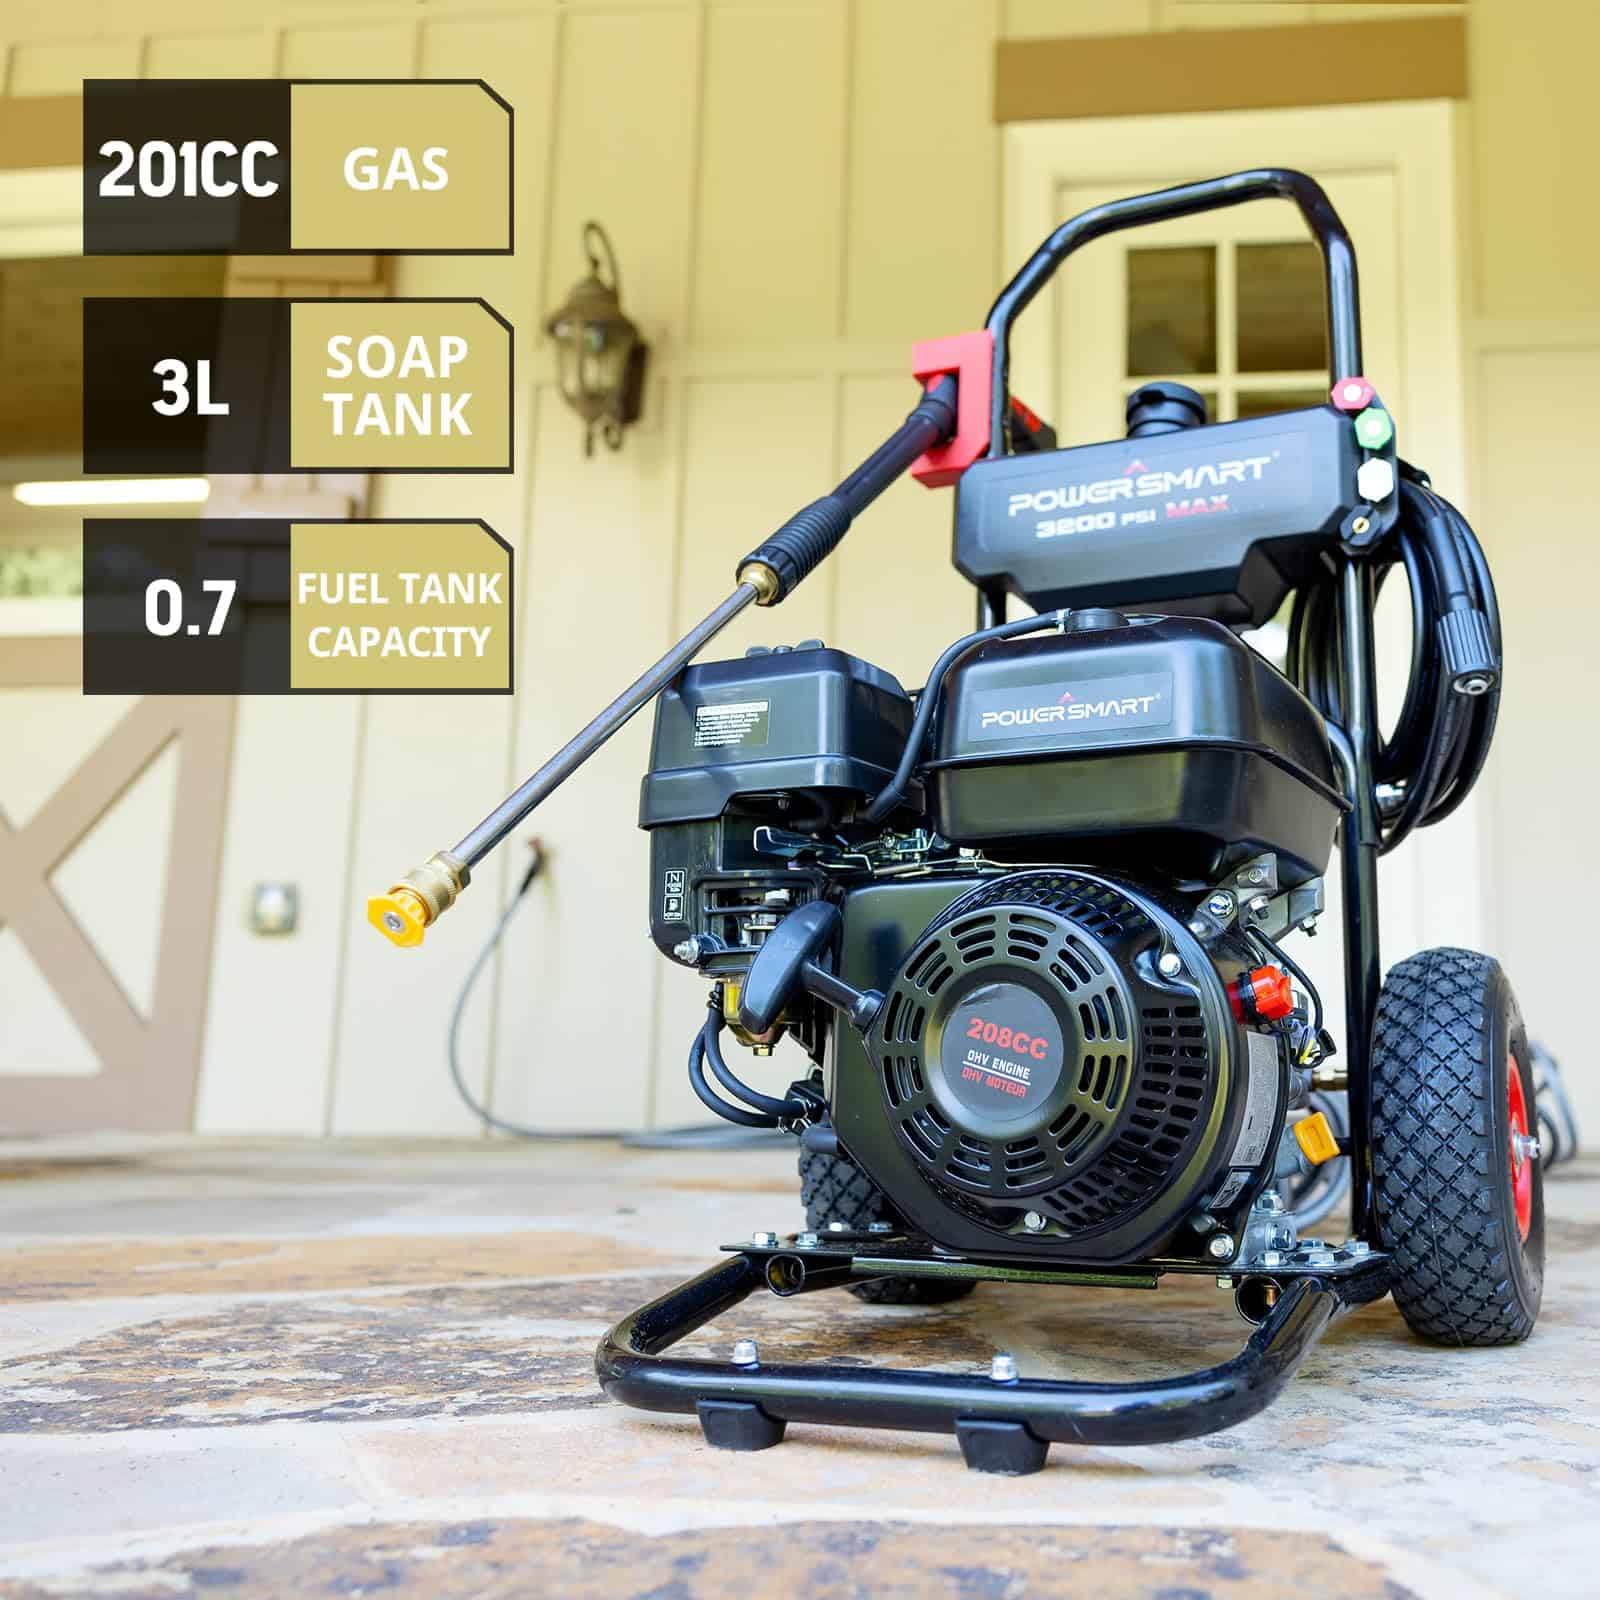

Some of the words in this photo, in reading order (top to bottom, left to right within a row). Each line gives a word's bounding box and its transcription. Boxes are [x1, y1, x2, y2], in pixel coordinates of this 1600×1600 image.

[1036, 511, 1116, 539] 3200
[1120, 508, 1156, 526] PSI
[1166, 494, 1231, 519] MAX
[967, 1018, 1047, 1058] 208CC
[962, 1067, 982, 1083] OHV
[986, 1075, 1027, 1096] MOTEUR
[967, 1049, 989, 1065] OHV
[992, 1058, 1030, 1079] ENGINE
